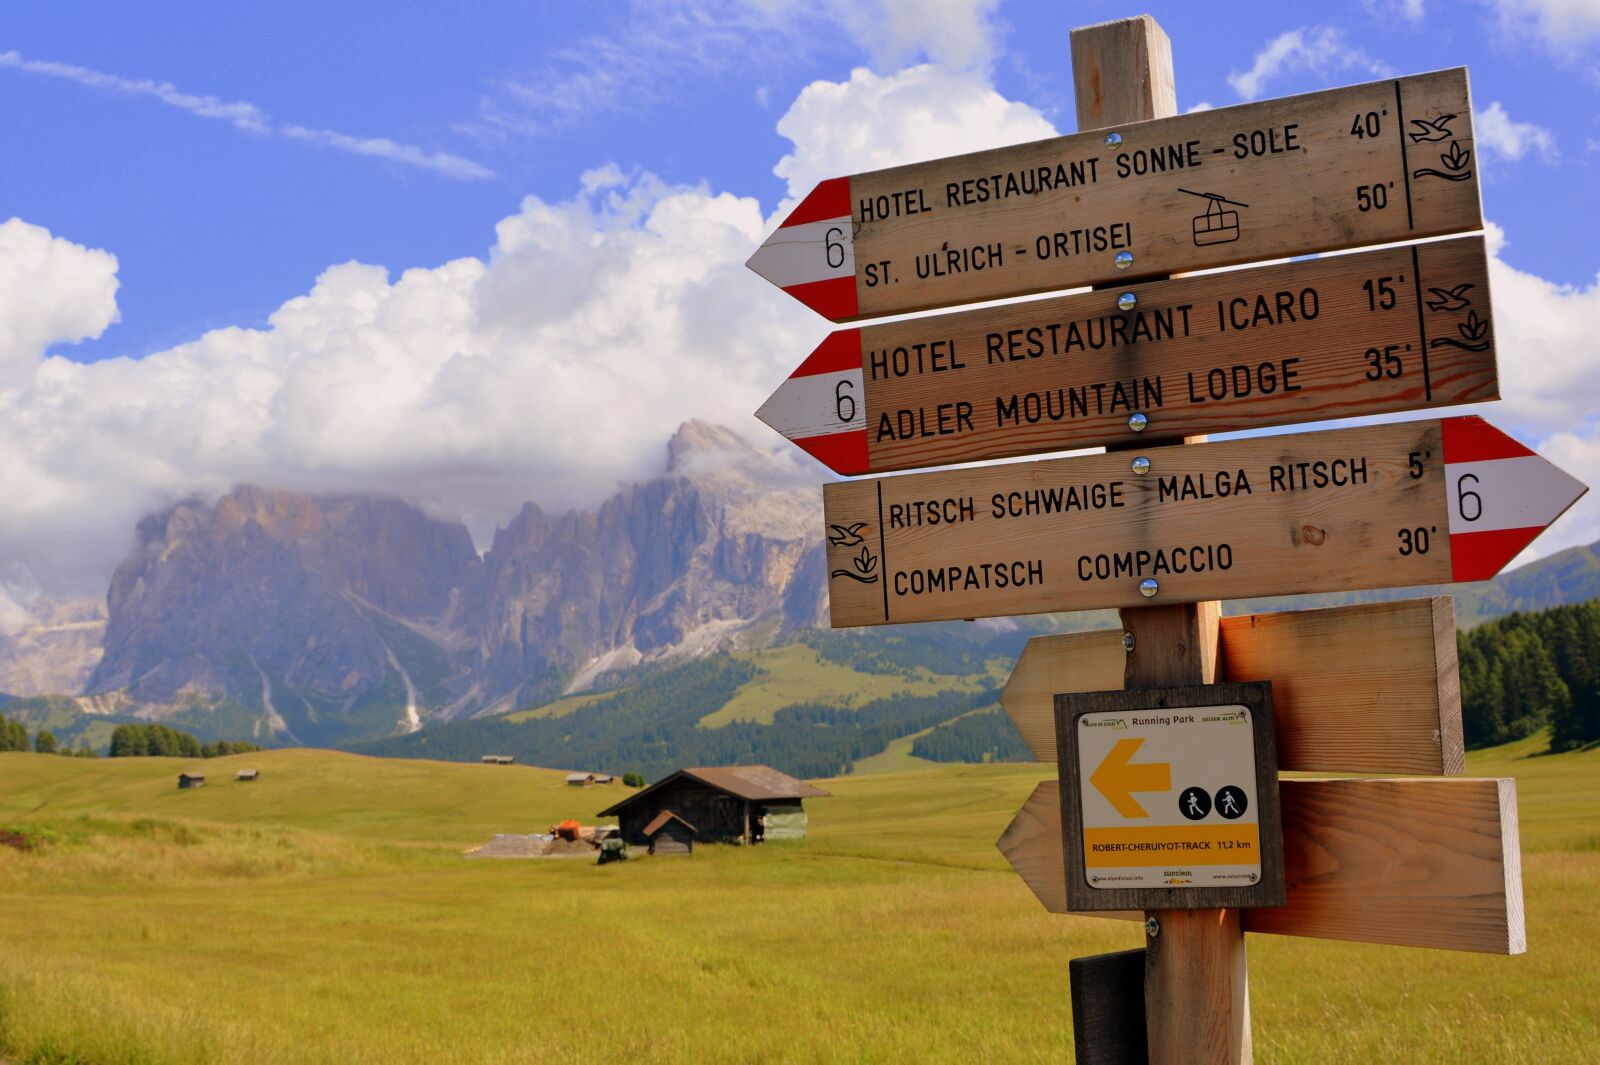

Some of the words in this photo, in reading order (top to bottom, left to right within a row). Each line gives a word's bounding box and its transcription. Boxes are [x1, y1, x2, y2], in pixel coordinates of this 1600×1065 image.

[860, 188, 932, 222] HOTEL
[946, 158, 1099, 208] RESTAURANT
[1116, 141, 1202, 178] SONNE
[1233, 124, 1300, 159] SOLE
[826, 227, 844, 268] 6
[865, 260, 899, 287] ST.
[915, 242, 1003, 279] ULRICH
[1036, 222, 1132, 260] ORTISEI
[870, 340, 965, 381] HOTEL
[986, 304, 1193, 364] RESTAURANT
[1218, 287, 1319, 331] ICARO
[836, 380, 855, 422] 6
[877, 401, 974, 443] ADLER
[996, 376, 1163, 427] MOUNTAIN
[1188, 357, 1302, 403] LODGE
[890, 497, 974, 528] RITSCH
[991, 481, 1125, 519] SCHWAIGE
[1158, 469, 1252, 502] MALGA
[1269, 457, 1367, 492] RITSCH
[1457, 473, 1482, 521] 6
[894, 559, 1043, 596] COMPATSCH
[1078, 543, 1232, 581] COMPACCIO
[1132, 716, 1171, 726] Running
[1173, 714, 1195, 724] Park
[1092, 841, 1211, 852] ROBERT-CHERUIYOT-TRACK
[1217, 840, 1234, 850] 11,2
[1237, 840, 1251, 849] km
